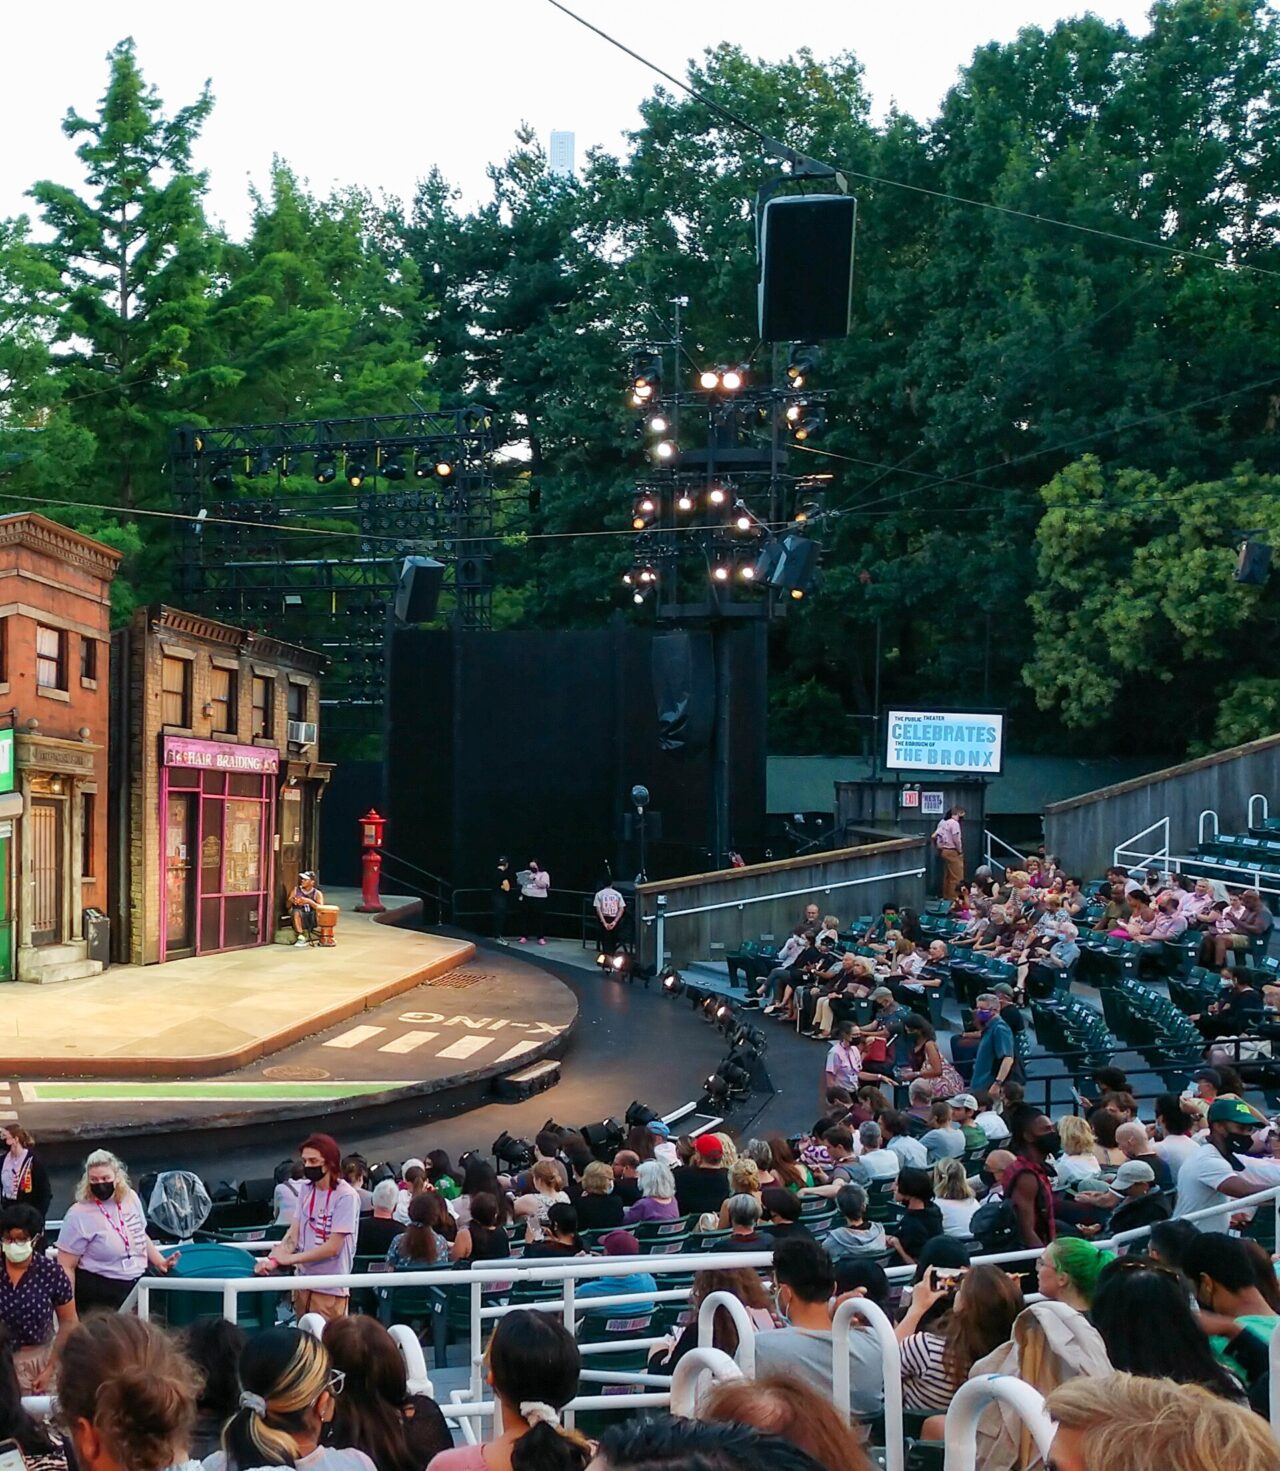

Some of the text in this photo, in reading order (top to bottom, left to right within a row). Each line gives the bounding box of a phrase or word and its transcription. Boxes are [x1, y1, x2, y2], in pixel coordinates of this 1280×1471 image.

[892, 723, 997, 743] CELEBRATES
[188, 751, 261, 770] HAIR BRAIDING
[895, 748, 994, 767] THE BRONX
[904, 792, 917, 805] EXIT
[398, 1011, 570, 1036] X-ING
